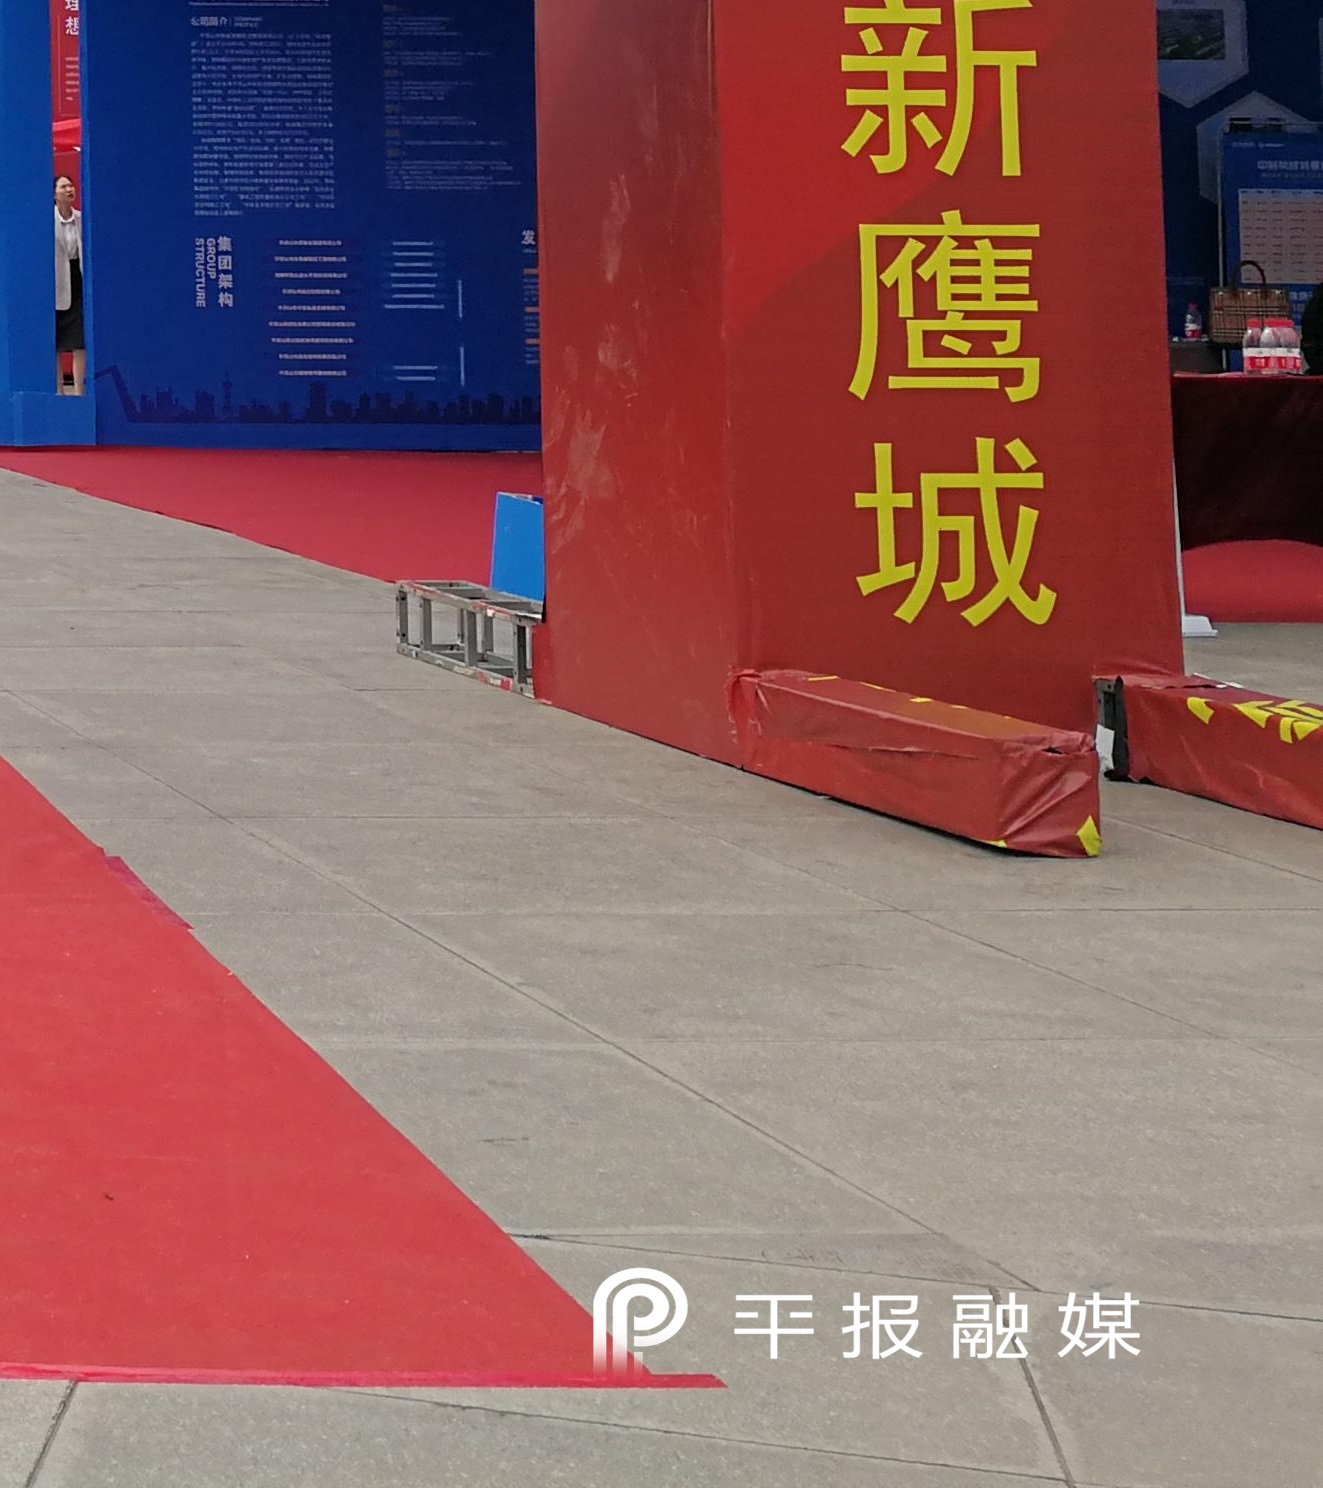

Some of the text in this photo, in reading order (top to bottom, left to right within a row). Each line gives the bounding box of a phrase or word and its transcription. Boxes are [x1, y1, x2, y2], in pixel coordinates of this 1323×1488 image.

[194, 237, 206, 308] STRUCTURE
[206, 237, 217, 280] GROUP
[216, 235, 234, 308] 集团架构
